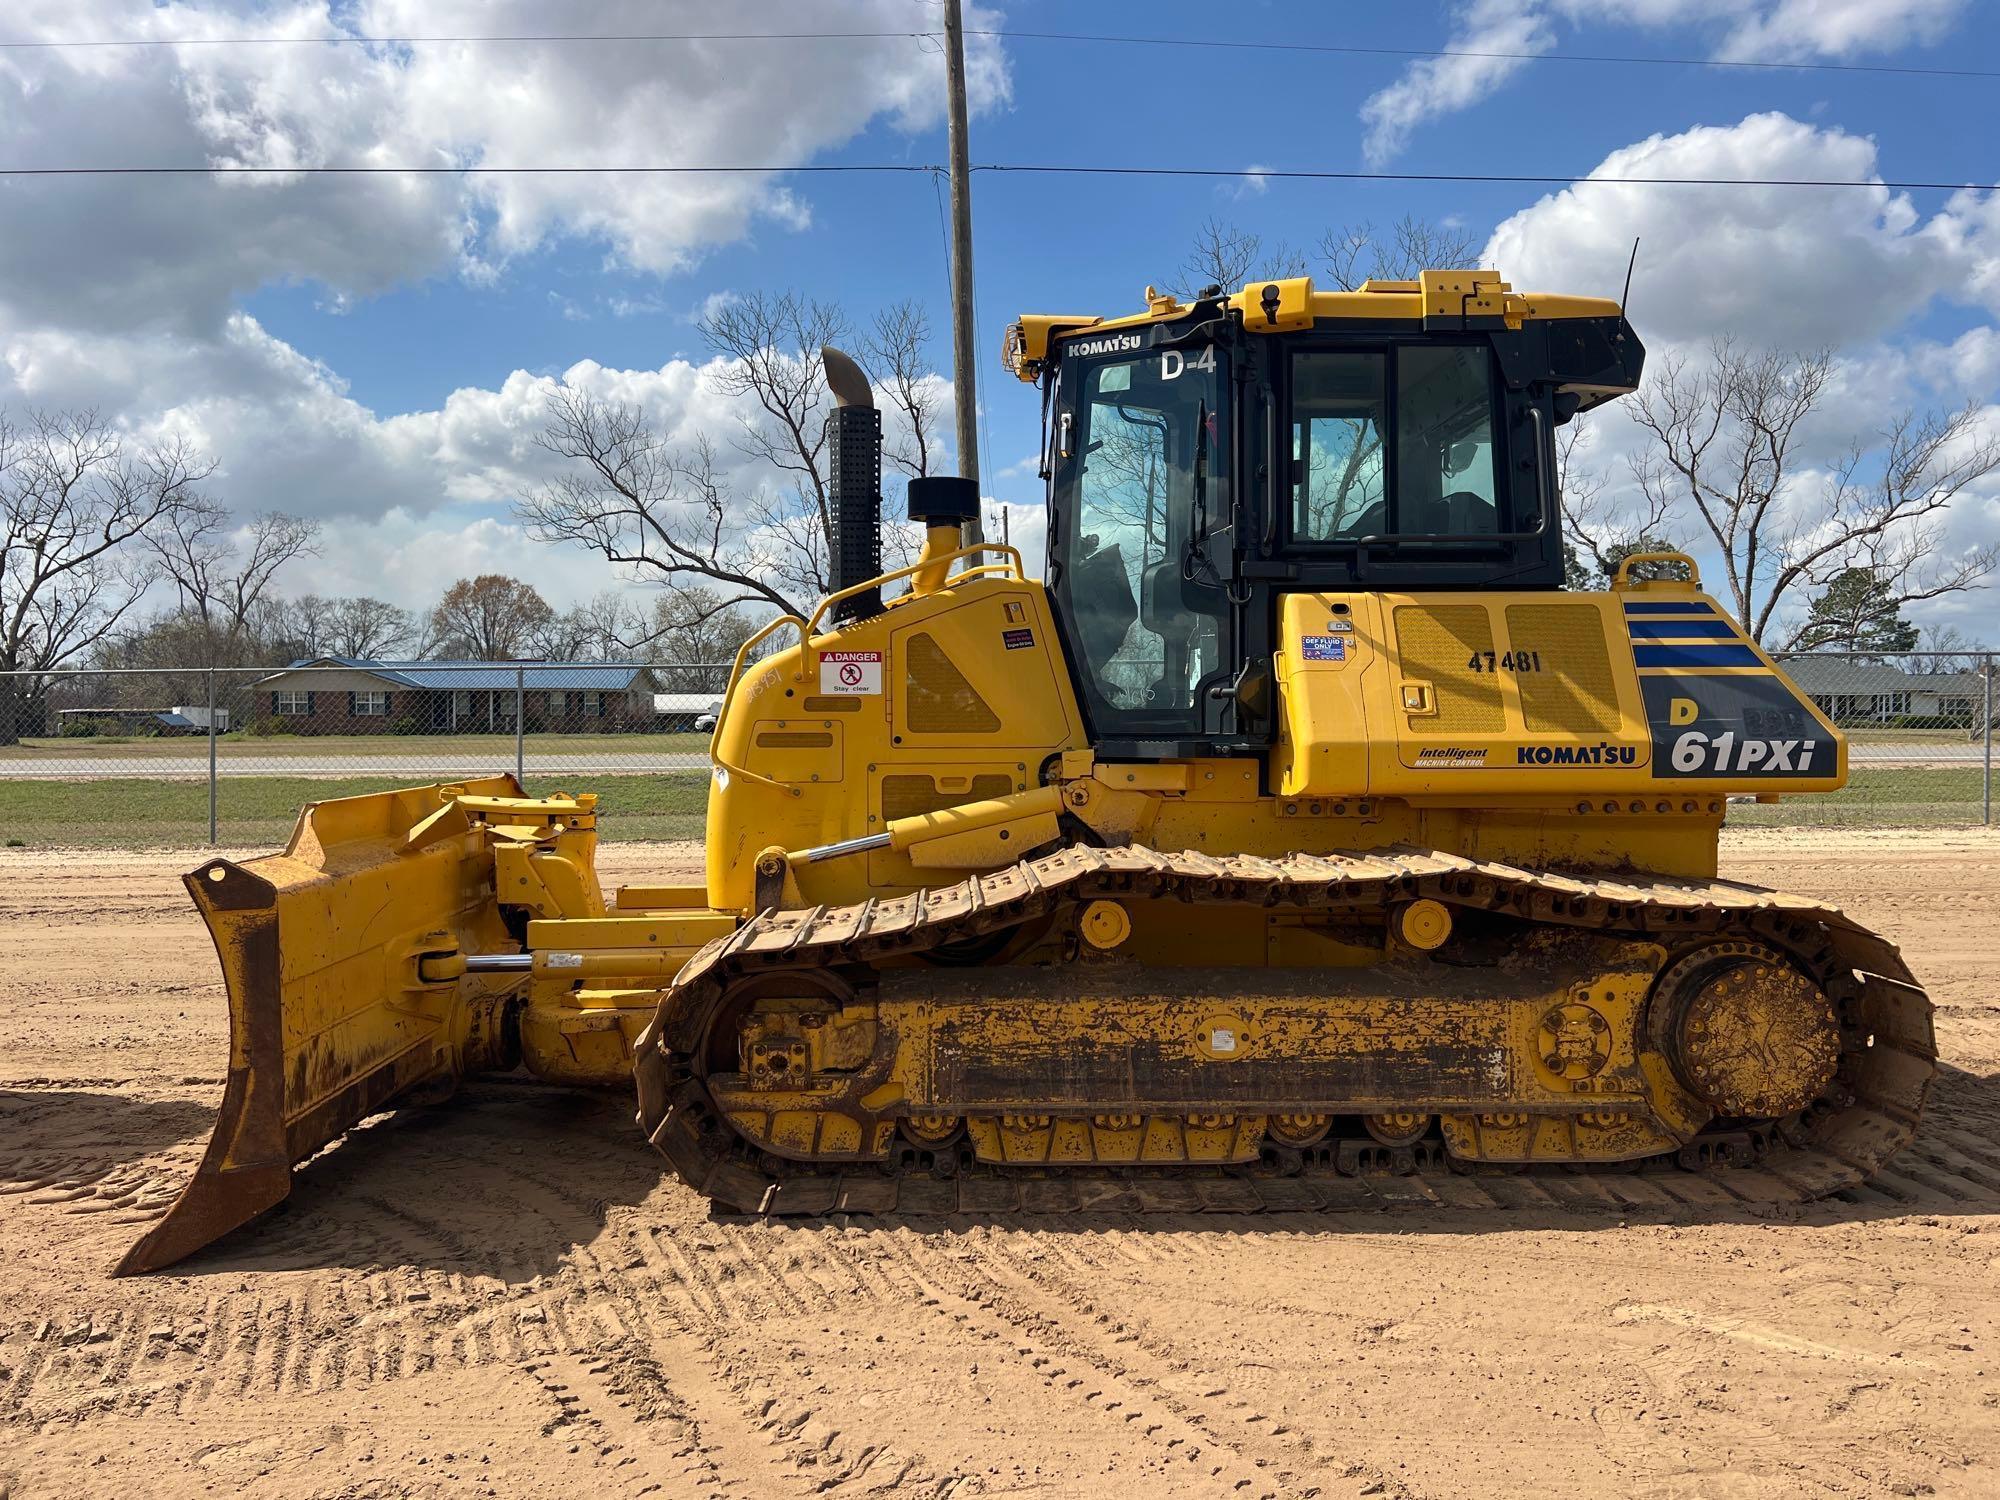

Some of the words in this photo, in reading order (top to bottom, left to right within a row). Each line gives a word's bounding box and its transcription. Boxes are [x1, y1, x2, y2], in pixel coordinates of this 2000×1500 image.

[1068, 334, 1141, 358] KOMATSU
[1161, 344, 1217, 381] D-4
[835, 653, 878, 662] DANGER
[1468, 650, 1541, 674] 47481
[833, 685, 849, 693] Stay
[1669, 698, 1699, 726] D
[1414, 759, 1450, 767] MACHINE
[1450, 759, 1485, 767] CONTROL
[1419, 747, 1488, 760] intelligent
[1517, 741, 1636, 764] KOMATSU
[1671, 731, 1816, 772] 61PXi
